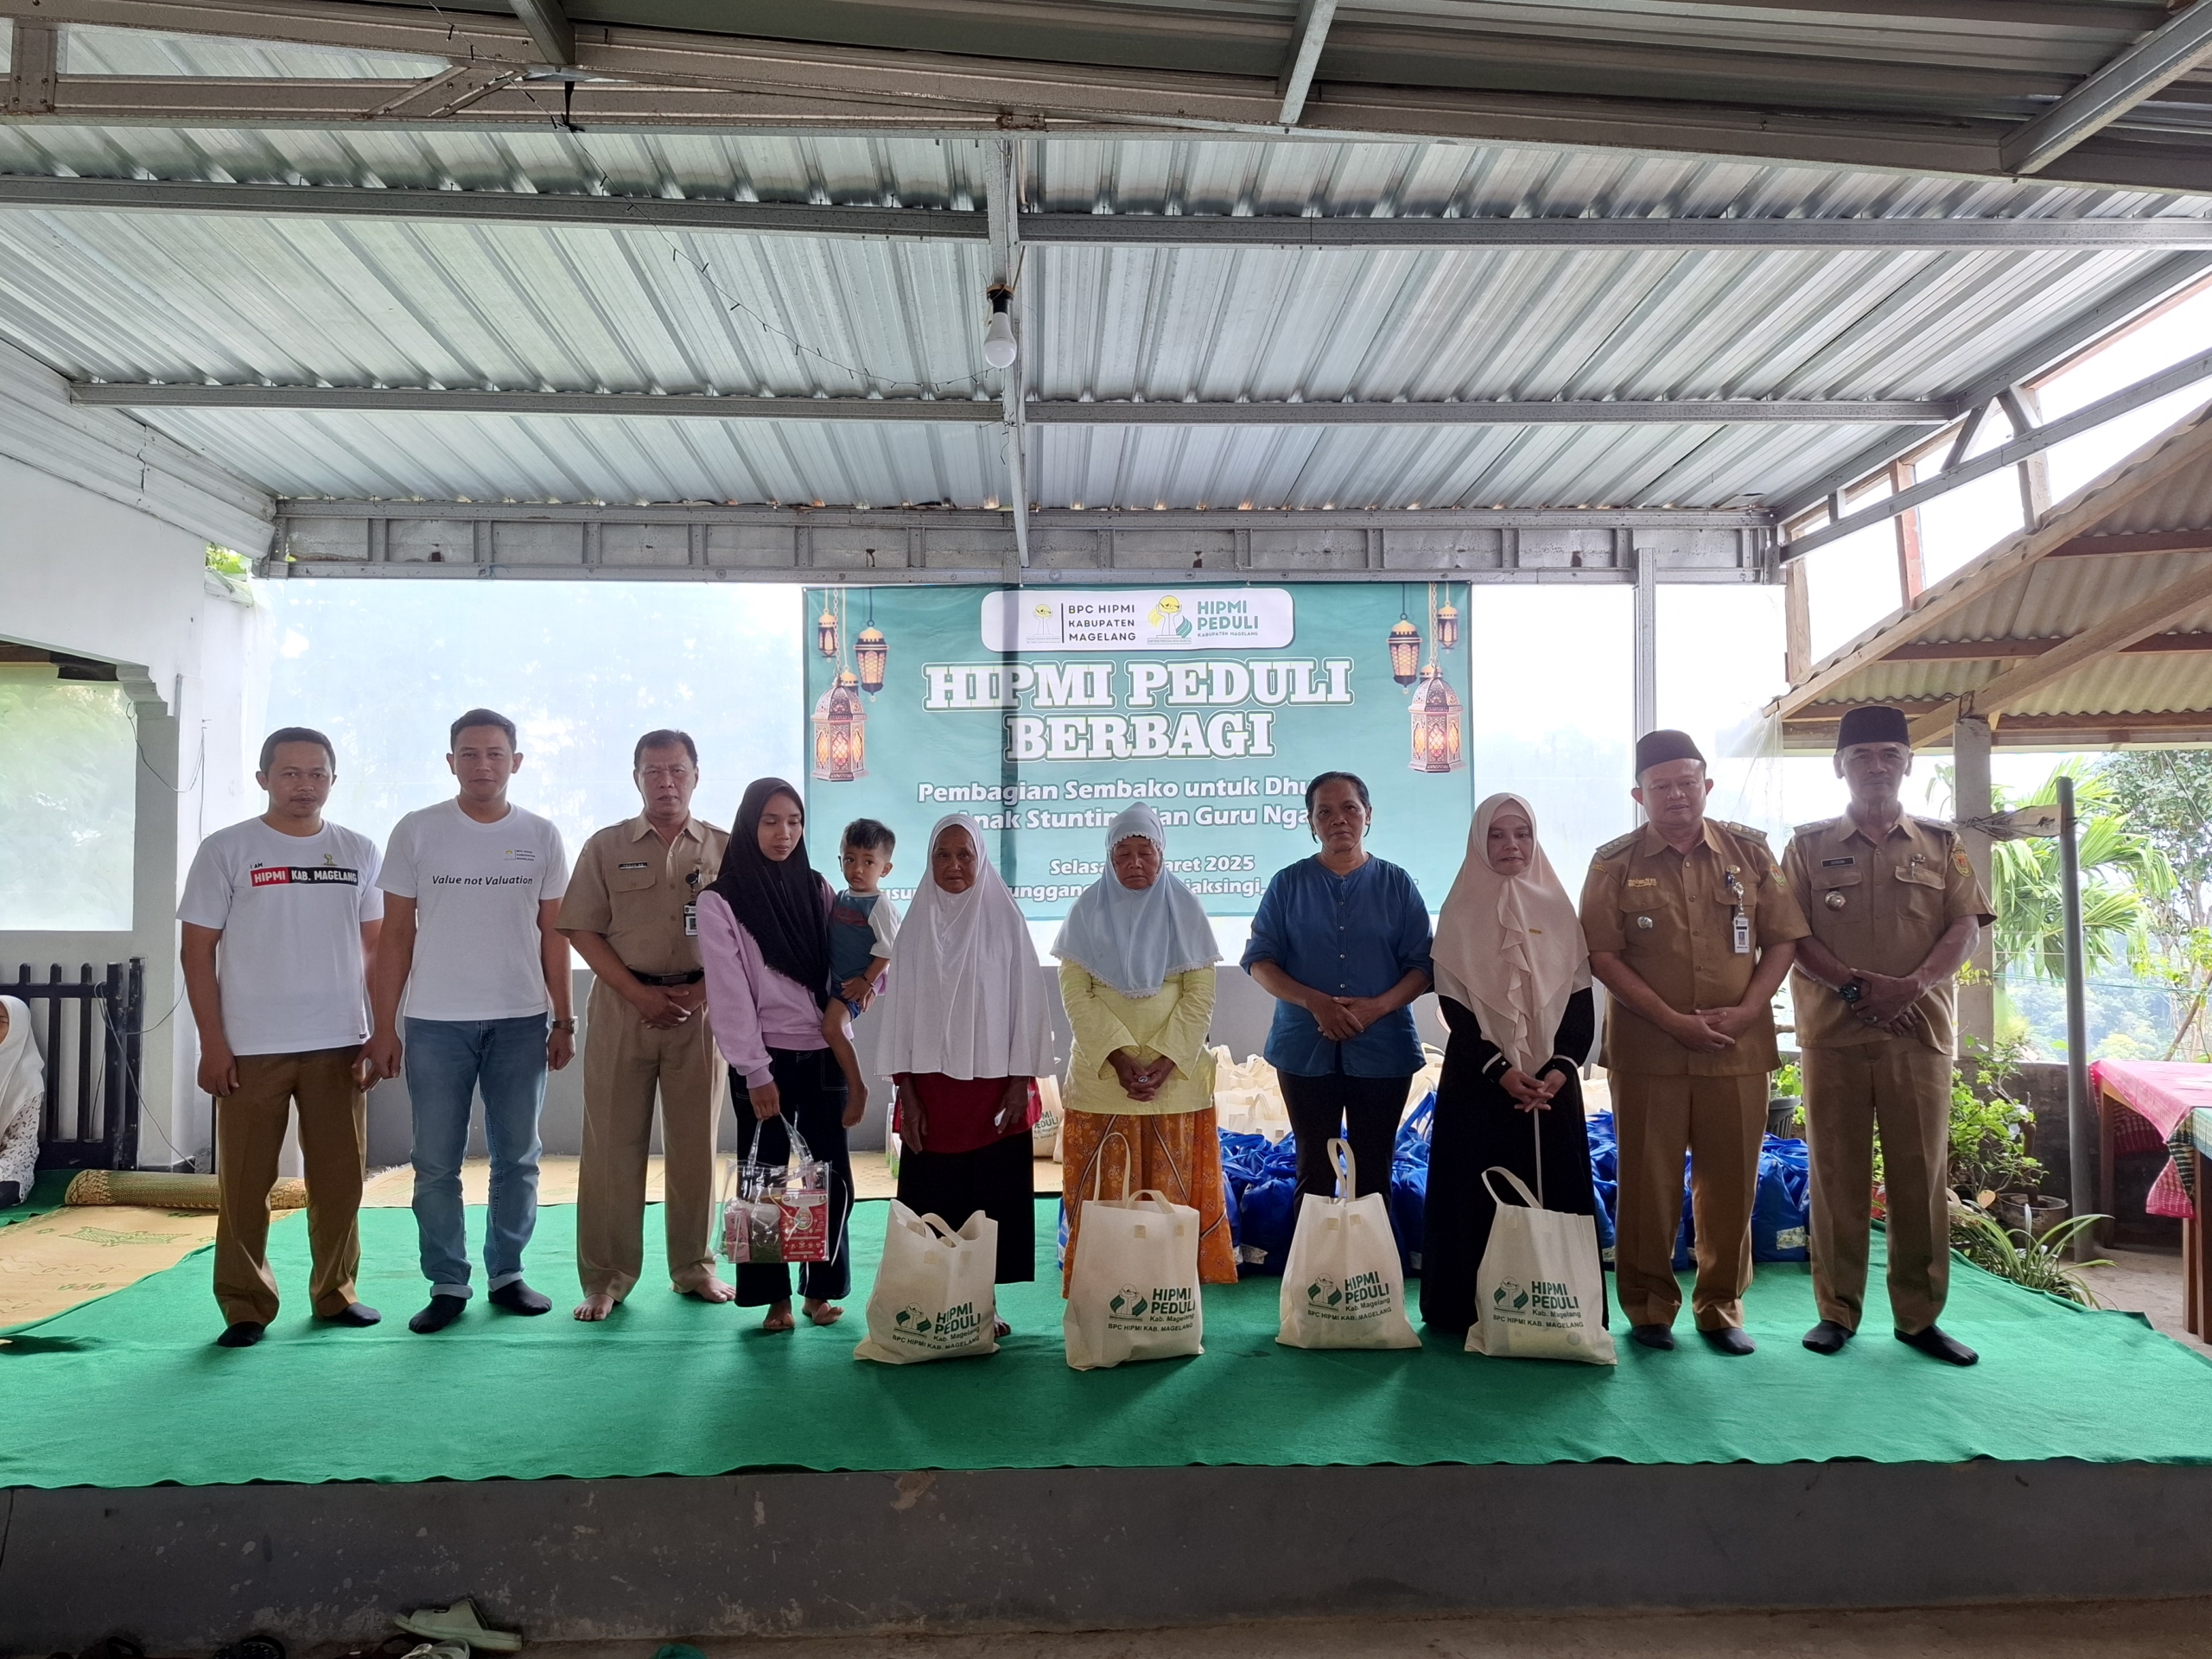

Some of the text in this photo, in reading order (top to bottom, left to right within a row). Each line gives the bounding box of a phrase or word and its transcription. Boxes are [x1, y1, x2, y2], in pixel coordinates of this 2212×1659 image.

[1068, 604, 1135, 614] BPC HIPMI
[1197, 600, 1247, 615] HIPMI
[1068, 619, 1135, 628] KABUPATEN
[1197, 615, 1259, 631] PEDULI
[1068, 632, 1137, 642] MAGELANG
[924, 660, 1351, 710] HIPMI PEDULI
[1006, 713, 1274, 760] BERBAGI
[918, 782, 1058, 805] Pembagian
[1065, 779, 1179, 799] Sembako
[1185, 777, 1259, 797] untuk
[960, 810, 1021, 830] nak
[1026, 808, 1119, 829] Stuntin
[1195, 805, 1256, 826] Guru
[1163, 856, 1202, 872] aret
[1205, 855, 1255, 872] 2025
[253, 869, 358, 884] HIPMI KAB. MAGELANG
[432, 874, 533, 886] Value not Valuation
[1344, 1271, 1380, 1292] HIPMI
[1531, 1281, 1568, 1296] HIPMI
[1152, 1287, 1192, 1301] HIPMI
[1344, 1282, 1390, 1305] PEDULI
[1150, 1299, 1196, 1314] PEDULI
[1360, 1297, 1391, 1309] Magelang
[1532, 1294, 1580, 1310] PEDULI
[936, 1301, 973, 1325] HIPMI
[1166, 1313, 1195, 1323] Magelang
[1307, 1309, 1320, 1318] BPC
[1321, 1313, 1339, 1321] HIPMI
[1358, 1306, 1392, 1320] MAGELANG
[1532, 1308, 1582, 1319] Kab. Magelang
[934, 1312, 982, 1335] PEDULI
[1160, 1322, 1193, 1332] MAGELANG
[1507, 1317, 1526, 1325] HIPMI
[933, 1326, 981, 1343] Kab. Magelang
[892, 1334, 981, 1351] BPC HIPMI KAB. MAGELANG
